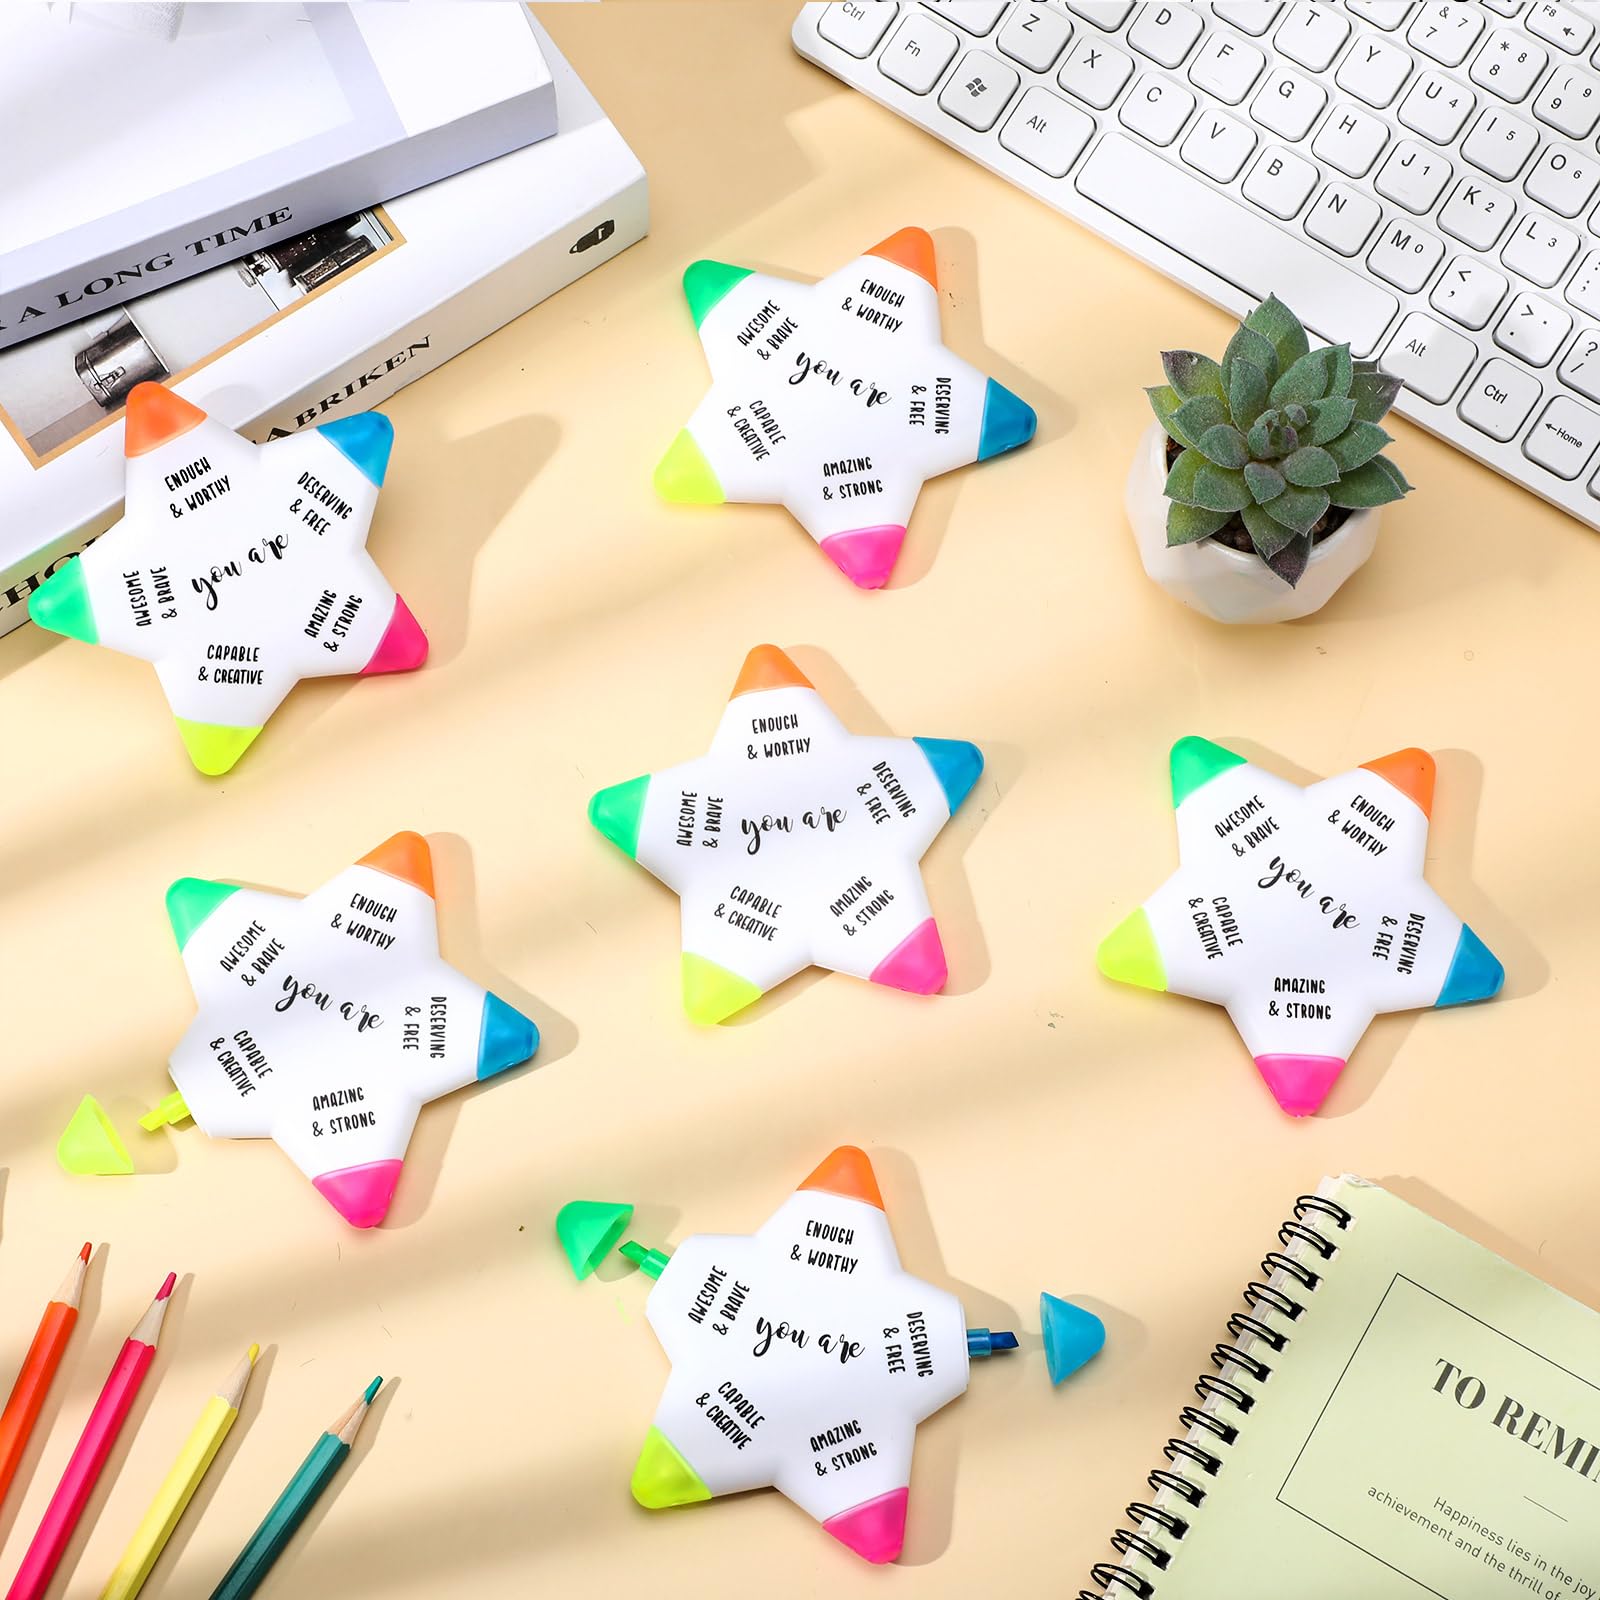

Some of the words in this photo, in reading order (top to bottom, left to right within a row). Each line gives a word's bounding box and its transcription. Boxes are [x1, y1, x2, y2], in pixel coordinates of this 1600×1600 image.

[843, 2, 865, 20] Ctrl
[1021, 12, 1041, 33] Z
[1154, 7, 1172, 26] D
[1305, 8, 1321, 27] T
[1543, 5, 1556, 17] F8
[1425, 26, 1438, 38] 7
[904, 39, 921, 58] Fn
[1082, 48, 1103, 69] X
[1216, 43, 1235, 59] F
[1365, 44, 1382, 63] Y
[1488, 63, 1501, 76] 8
[1146, 86, 1163, 103] C
[1278, 80, 1295, 99] G
[1425, 81, 1443, 100] U
[1550, 97, 1563, 110] 9
[1026, 115, 1047, 133] Alt
[1210, 121, 1227, 140] V
[1338, 114, 1358, 135] H
[1505, 130, 1517, 141] 5
[1266, 157, 1284, 177] B
[1400, 153, 1417, 168] J
[1550, 153, 1567, 171] O
[1572, 169, 1583, 180] 6
[1327, 193, 1348, 214] N
[1462, 185, 1482, 206] K
[1484, 201, 1495, 214] 2
[1390, 228, 1412, 251] M
[1525, 220, 1537, 240] L
[18, 306, 46, 323] A
[55, 252, 176, 309] LONG
[185, 206, 293, 257] TIME
[861, 279, 904, 307] ENOUGH
[737, 300, 780, 346] AWESOME
[842, 297, 852, 311] &
[857, 304, 902, 332] WORTHY
[757, 349, 770, 360] &
[767, 317, 798, 350] BRAVE
[1405, 339, 1426, 357] Alt
[789, 351, 843, 385] you
[850, 378, 891, 407] are
[912, 385, 926, 394] &
[935, 378, 951, 434] DESERVING
[1484, 385, 1508, 404] Ctrl
[750, 401, 786, 445] CAPABLE
[909, 401, 925, 425] FREE
[727, 406, 741, 417] &
[734, 419, 769, 461] CREATIVE
[1556, 428, 1582, 448] Home
[165, 457, 211, 491] ENOUGH
[824, 457, 872, 477] AMAZING
[170, 504, 183, 518] &
[185, 475, 230, 510] WORTHY
[297, 472, 352, 519] DESERVING
[823, 487, 833, 500] &
[840, 480, 883, 498] STRONG
[290, 499, 302, 514] &
[302, 509, 331, 535] FREE
[150, 567, 174, 603] BRAVE
[192, 561, 241, 610] you
[248, 534, 289, 563] are
[123, 571, 151, 626] AWESOME
[162, 608, 177, 618] &
[304, 590, 336, 638] AMAZING
[323, 642, 339, 652] &
[332, 595, 362, 637] STRONG
[207, 645, 259, 662] CAPABLE
[198, 666, 208, 681] &
[214, 669, 263, 684] CREATIVE
[752, 714, 798, 734] ENOUGH
[748, 745, 757, 759] &
[764, 738, 810, 758] WORTHY
[857, 783, 871, 796] &
[865, 797, 890, 824] FREE
[873, 761, 916, 817] DESERVING
[676, 791, 697, 846] AWESOME
[704, 796, 723, 832] BRAVE
[1215, 795, 1264, 837] AWESOME
[1351, 795, 1395, 831] ENOUGH
[703, 838, 718, 848] &
[742, 815, 792, 855] you
[803, 807, 846, 832] are
[1232, 844, 1245, 856] &
[1244, 817, 1279, 848] BRAVE
[1328, 810, 1340, 824] &
[1342, 820, 1387, 856] WORTHY
[730, 886, 782, 918] CAPABLE
[830, 876, 872, 916] AMAZING
[1189, 898, 1203, 908] &
[1258, 856, 1313, 898] you
[1320, 896, 1360, 929] are
[350, 893, 397, 922] ENOUGH
[714, 903, 725, 917] &
[728, 911, 777, 941] CREATIVE
[843, 925, 856, 936] &
[856, 890, 894, 925] STRONG
[1212, 897, 1243, 946] CAPABLE
[1382, 916, 1398, 927] &
[220, 920, 265, 972] AWESOME
[331, 914, 341, 928] &
[347, 921, 395, 950] WORTHY
[1193, 912, 1223, 959] CREATIVE
[1372, 932, 1393, 960] FREE
[1397, 913, 1425, 974] DESERVING
[241, 974, 256, 986] &
[251, 938, 285, 974] BRAVE
[1275, 977, 1325, 993] AMAZING
[275, 975, 332, 1012] you
[340, 1002, 383, 1032] are
[405, 1007, 421, 1016] &
[1269, 1001, 1279, 1016] &
[1287, 1003, 1331, 1019] STRONG
[403, 1024, 419, 1050] FREE
[430, 997, 446, 1058] DESERVING
[210, 1038, 225, 1051] &
[218, 1051, 255, 1097] CREATIVE
[234, 1031, 272, 1078] CAPABLE
[313, 1087, 364, 1111] AMAZING
[313, 1122, 323, 1136] &
[330, 1112, 375, 1134] STRONG
[806, 1220, 854, 1244] ENOUGH
[791, 1244, 801, 1261] &
[808, 1249, 858, 1274] WORTHY
[688, 1266, 727, 1323] AWESOME
[720, 1281, 749, 1321] BRAVE
[713, 1324, 728, 1335] &
[753, 1317, 809, 1357] you
[818, 1334, 865, 1364] are
[883, 1328, 899, 1338] &
[886, 1345, 905, 1373] FREE
[907, 1312, 933, 1377] DESERVING
[718, 1382, 765, 1429] CAPABLE
[696, 1393, 710, 1408] &
[706, 1405, 752, 1450] CREATIVE
[1432, 1358, 1486, 1409] TO
[1491, 1395, 1600, 1483] REMI
[810, 1420, 861, 1452] AMAZING
[815, 1462, 827, 1476] &
[832, 1443, 877, 1471] STRONG
[1367, 1486, 1454, 1543] achievement
[1454, 1536, 1483, 1558] and
[1483, 1551, 1506, 1572] the
[1508, 1566, 1543, 1595] thrill
[1433, 1496, 1504, 1546] Happiness
[1506, 1538, 1531, 1562] lies
[1534, 1554, 1547, 1571] in
[1550, 1564, 1573, 1586] the
[1572, 1578, 1597, 1600] joy
